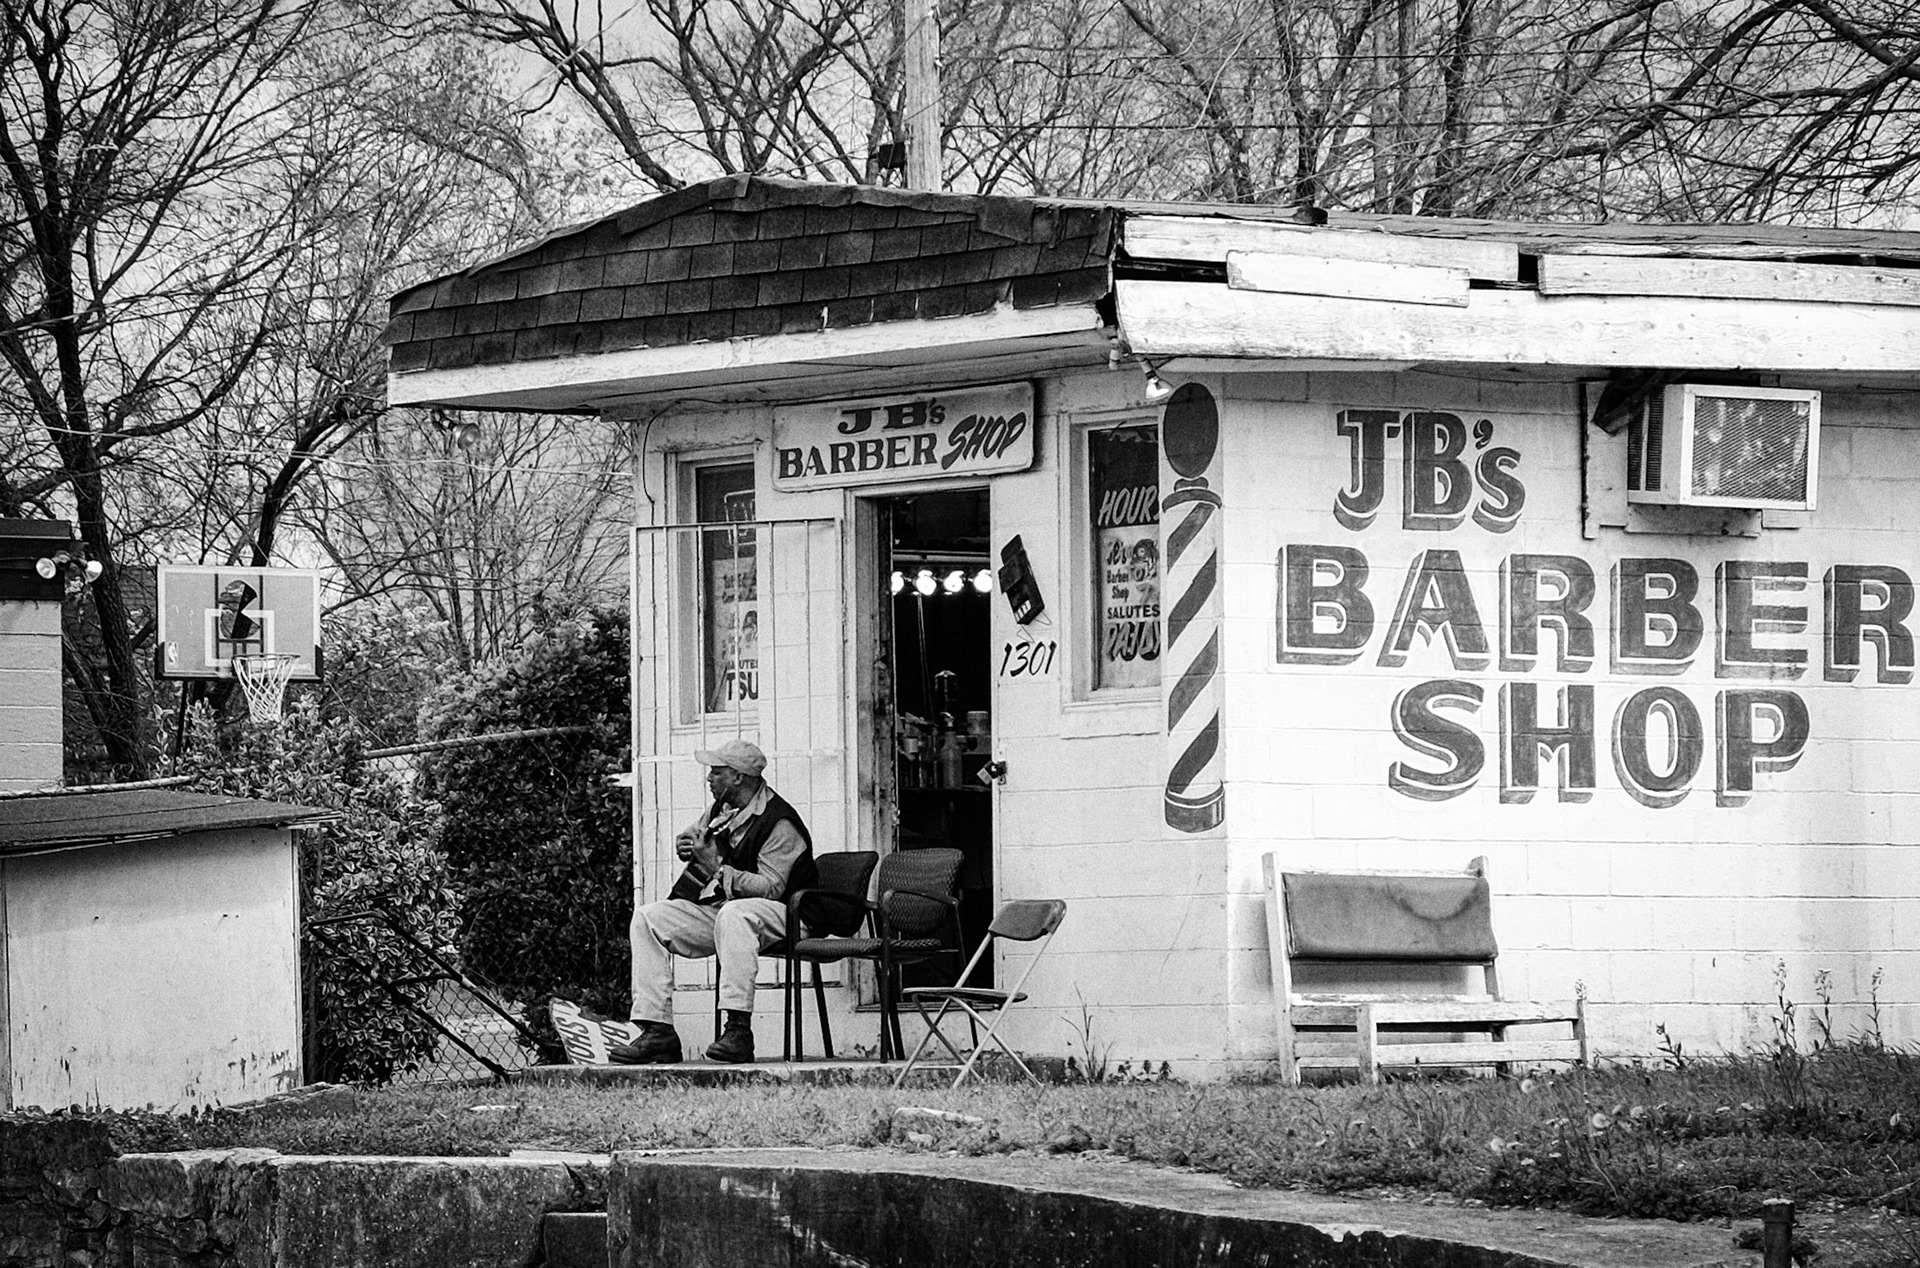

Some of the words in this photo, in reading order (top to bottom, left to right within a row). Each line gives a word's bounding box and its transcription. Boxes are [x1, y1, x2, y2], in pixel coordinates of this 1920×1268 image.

[838, 398, 946, 434] JB's
[776, 433, 938, 479] BARBER
[942, 412, 1027, 470] SHOP
[1333, 409, 1526, 533] JB's
[1098, 485, 1159, 525] HOUR
[1107, 604, 1160, 620] SALUTES
[1276, 544, 1915, 684] BARBER
[1000, 641, 1057, 677] 1301
[1389, 679, 1810, 808] SHOP
